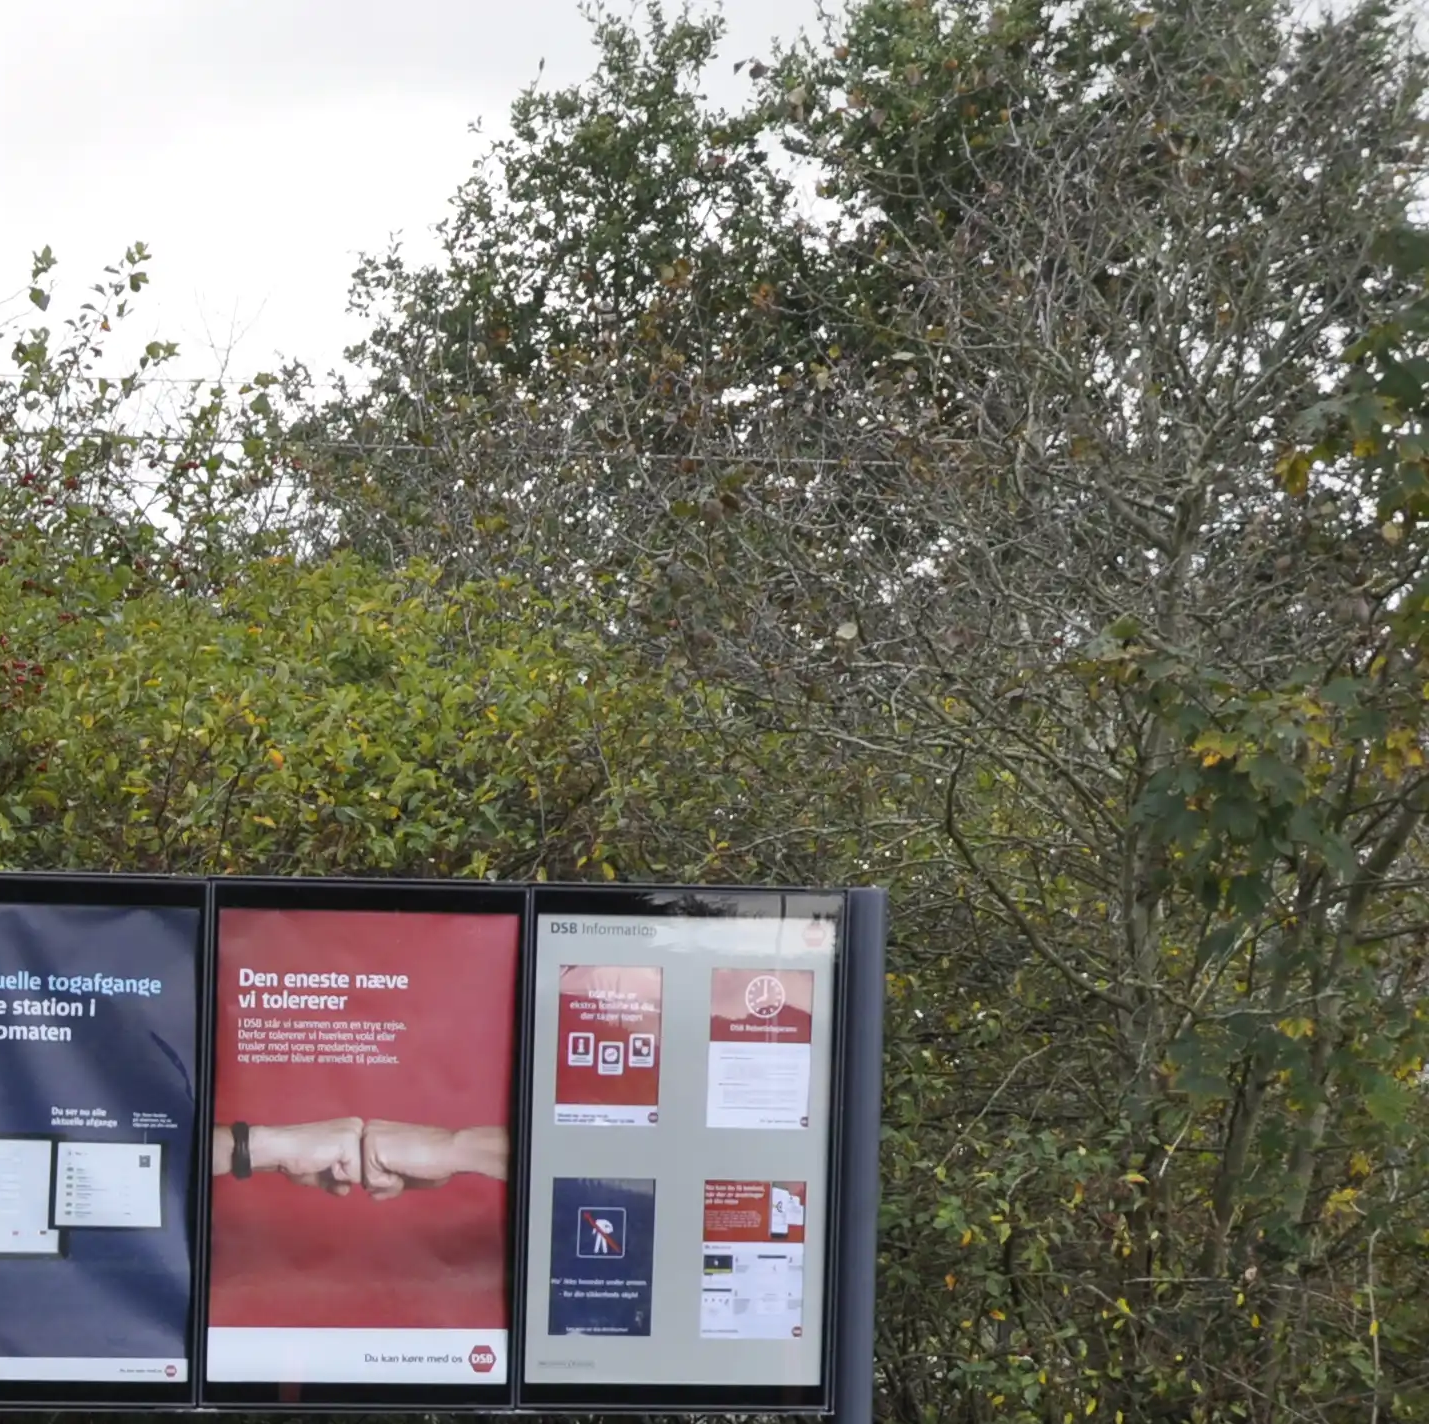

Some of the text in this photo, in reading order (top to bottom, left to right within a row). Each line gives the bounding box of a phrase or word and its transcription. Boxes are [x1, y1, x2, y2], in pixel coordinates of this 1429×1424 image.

[550, 921, 657, 938] DSB Information
[47, 973, 162, 997] togafgange
[239, 968, 409, 990] Den eneste næve
[12, 996, 83, 1017] station
[89, 998, 96, 1017] i
[238, 990, 348, 1010] vi tolererer
[569, 1000, 597, 1009] ekstra
[243, 1019, 262, 1029] DSB
[264, 1018, 281, 1029] står
[283, 1019, 292, 1029] vi
[293, 1020, 331, 1029] sammen
[332, 1021, 348, 1029] om
[349, 1021, 361, 1030] en
[363, 1021, 382, 1032] tryg
[237, 1029, 396, 1042] Derfor tolererer vi hverken vold eller
[238, 1041, 266, 1051] trusler
[267, 1041, 289, 1051] mod
[291, 1044, 315, 1052] vores
[237, 1054, 250, 1064] og
[251, 1053, 289, 1064] episoder
[291, 1053, 316, 1063] bliver
[317, 1053, 353, 1064] anmeldt
[355, 1053, 365, 1064] til
[51, 1106, 63, 1116] Du
[65, 1108, 78, 1116] ser
[92, 1107, 107, 1116] alle
[51, 1117, 118, 1128] aktuelle afgange
[364, 1353, 378, 1363] Du
[381, 1353, 399, 1363] kan
[402, 1353, 424, 1363] køre
[427, 1353, 449, 1363] med
[471, 1353, 494, 1364] DSB
